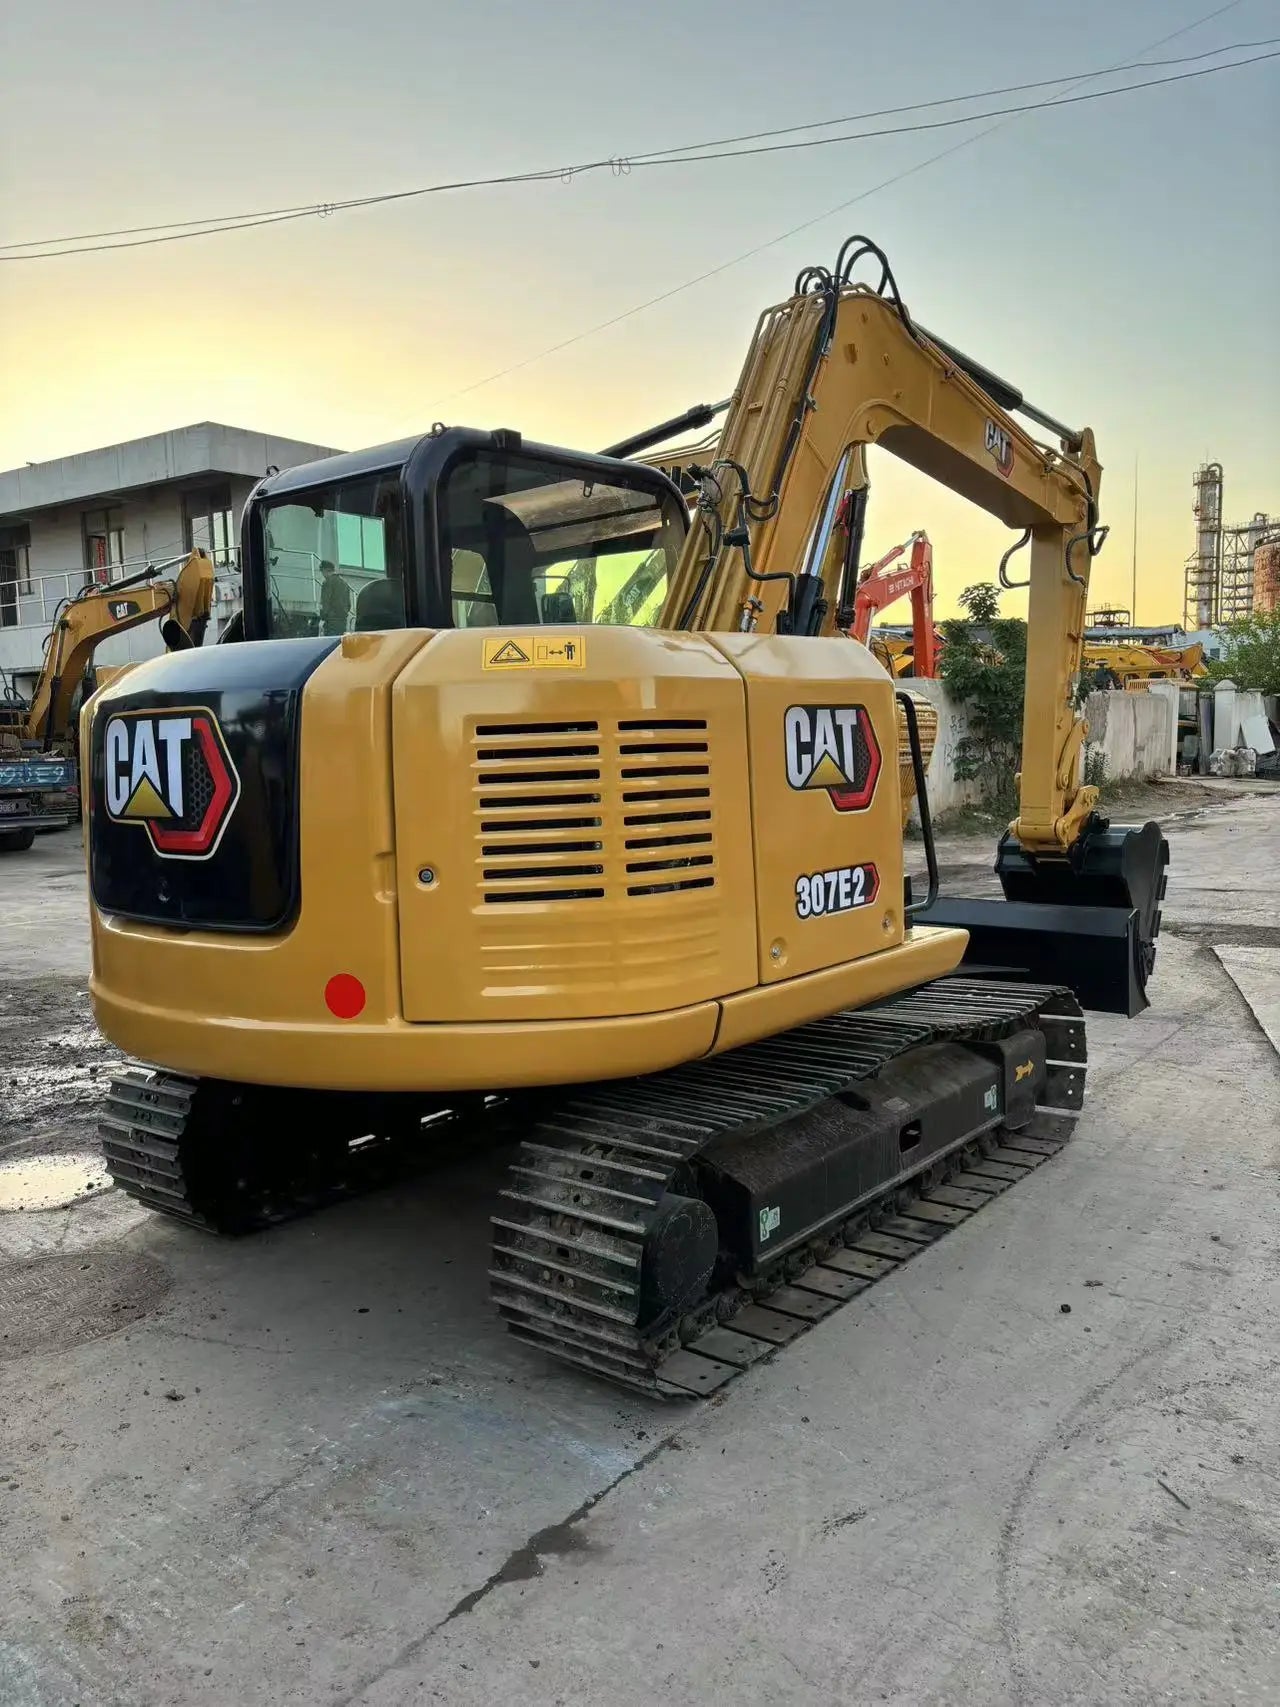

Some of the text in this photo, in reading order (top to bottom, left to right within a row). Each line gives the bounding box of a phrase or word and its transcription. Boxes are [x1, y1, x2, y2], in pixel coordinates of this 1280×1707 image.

[985, 420, 1009, 463] CAT
[116, 602, 128, 618] CAT
[107, 718, 191, 817] CAT
[785, 706, 857, 788] CAT
[796, 866, 865, 916] 307E2
